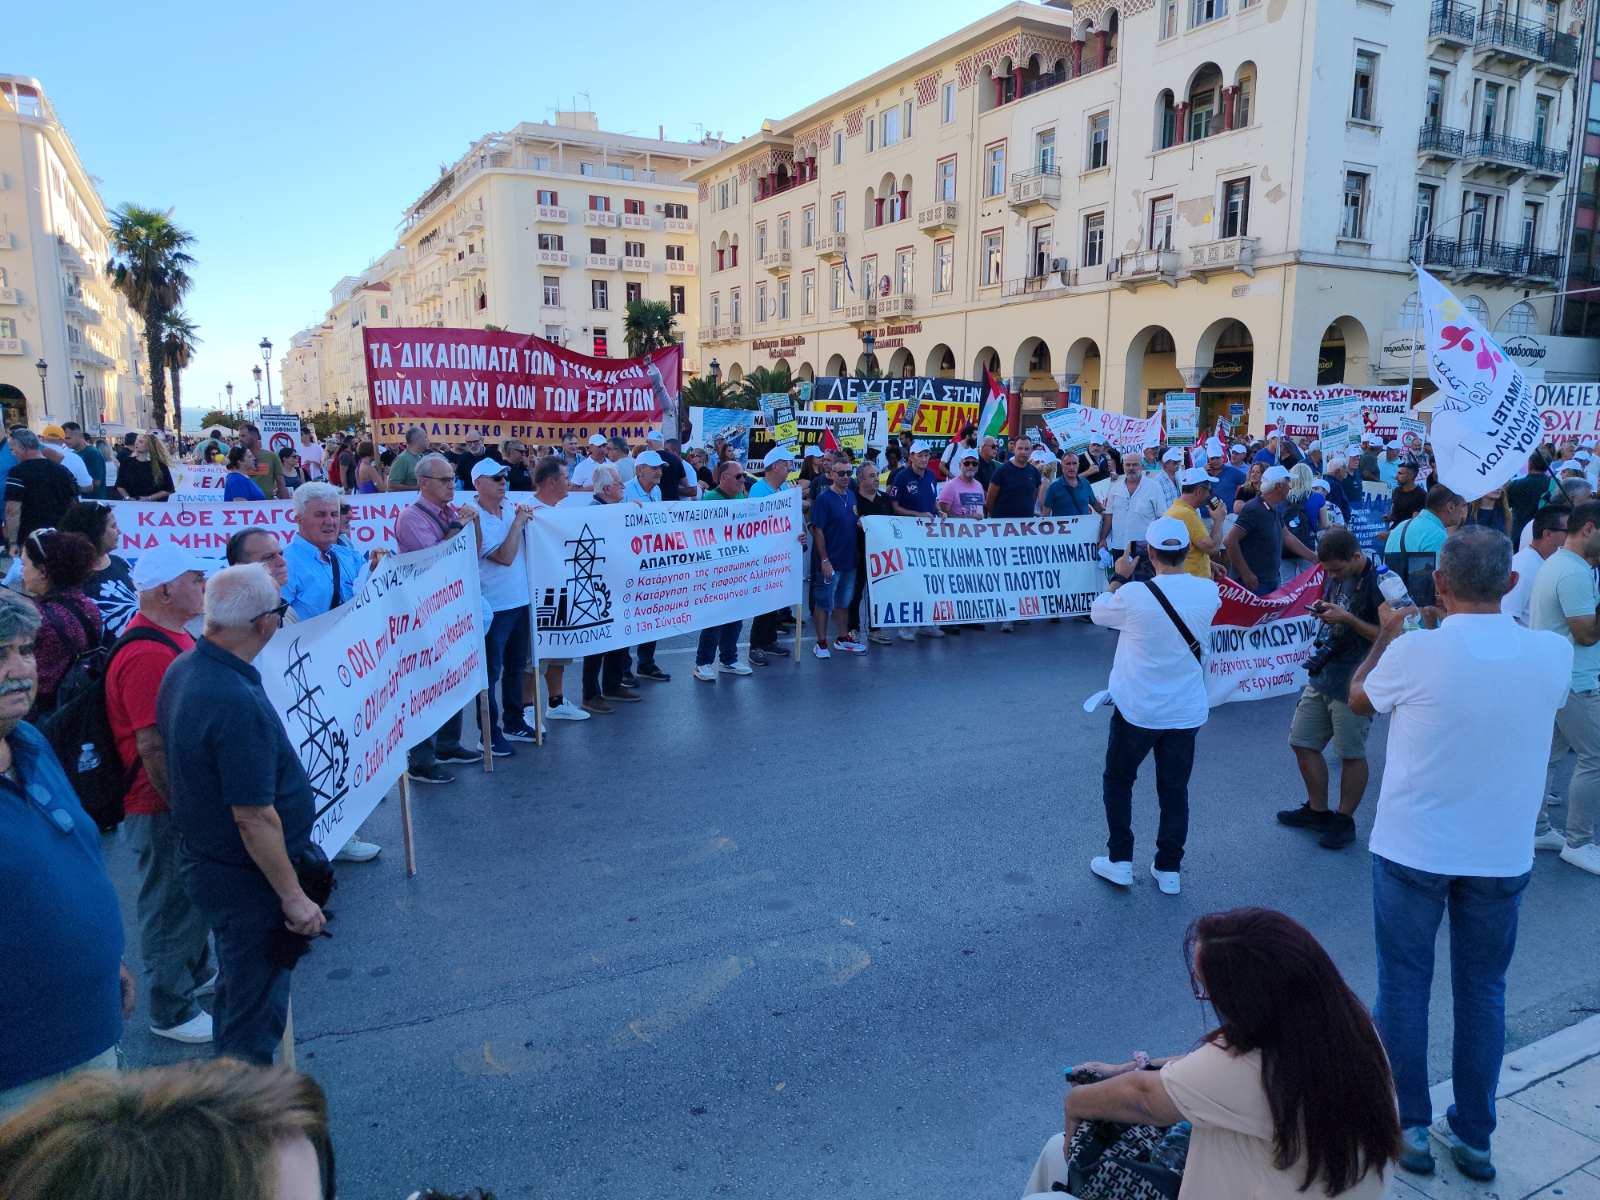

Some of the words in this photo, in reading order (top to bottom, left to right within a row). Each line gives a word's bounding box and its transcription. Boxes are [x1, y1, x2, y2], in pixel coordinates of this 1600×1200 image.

[370, 343, 392, 368] ΤΑ
[401, 343, 518, 372] ΔΙΚΑΙΩΜΑΤΑ
[524, 349, 555, 376] ΤΩΝ
[374, 380, 422, 406] ΕΙΝΑΙ
[431, 380, 489, 407] ΜΑΧΗ
[496, 383, 536, 410] ΟΛΩΝ
[544, 386, 579, 412] ΤΩΝ
[587, 388, 655, 412] ΕΡΓΑΤΩΝ
[942, 386, 981, 402] ΣΤΗΝ
[1269, 402, 1289, 411] ΤΟΥ
[1291, 402, 1319, 412] ΠΟΛΕ
[381, 423, 501, 436] ΣΟΣΑΛΙΣΤΙΚΟ
[138, 510, 214, 527] ΚΑΘΕ
[351, 503, 408, 520] ΕΙΝΑ
[625, 511, 667, 527] ΣΩΜΑΤΕΙΟ
[123, 533, 159, 549] ΝΑ
[630, 531, 688, 555] ΦΤΑΝΕΙ
[694, 527, 718, 547] ΠΙΑ
[724, 525, 732, 541] Η
[737, 514, 792, 540] ΚΟΡΟΪΔΙΑ
[639, 549, 713, 570] ΑΠΑΙΤΟΥΜΕ
[718, 545, 750, 557] ΤΩΡΑ:
[870, 547, 904, 577] ΟΧΙ
[905, 547, 927, 567] ΣΤΟ
[928, 547, 984, 568] ΕΓΚΛΗΜΑ
[984, 547, 1007, 567] ΤΟΥ
[637, 571, 690, 588] Κατάργηση
[695, 567, 710, 579] της
[924, 574, 946, 595] ΤΟΥ
[948, 573, 1001, 594] ΕΘΝΙΚΟΥ
[1004, 569, 1061, 592] ΠΛΟΥΤΟΥ
[635, 586, 688, 604] Κατάργηση
[693, 582, 707, 593] της
[1218, 584, 1270, 608] ΩΜΑΤΕΙΟ
[634, 599, 689, 618] Αναδρομικά
[933, 600, 955, 621] ΔΕΝ
[957, 598, 1007, 619] ΠΩΛΕΙΤΑΙ
[1019, 595, 1041, 616] ΔΕΝ
[549, 625, 613, 646] ΠΥΛΩΝΑΣ
[636, 622, 653, 634] 13η
[1210, 629, 1247, 654] ΝΟΜΟΥ
[347, 638, 376, 678] ΟΧΙ
